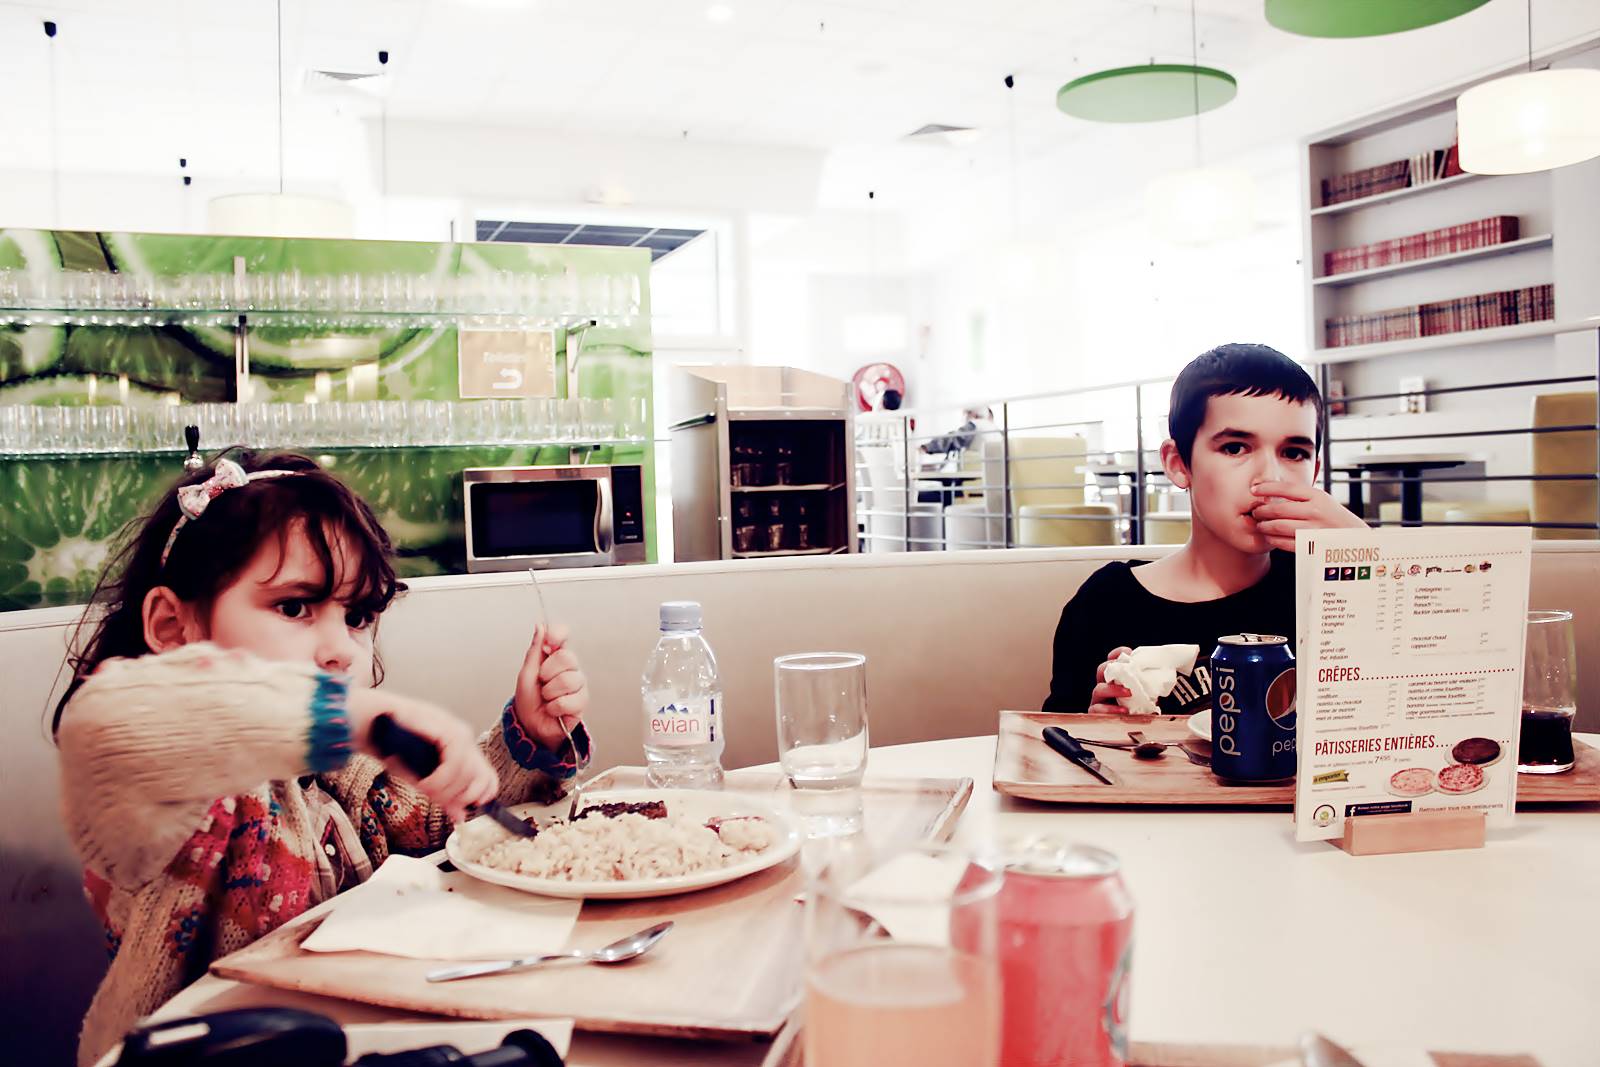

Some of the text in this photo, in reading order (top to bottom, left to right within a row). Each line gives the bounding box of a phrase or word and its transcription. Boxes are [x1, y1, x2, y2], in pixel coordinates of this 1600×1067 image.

[1325, 547, 1380, 563] BOISSONS
[1318, 666, 1360, 682] CRÊPES
[1216, 667, 1241, 756] pepsi
[652, 717, 699, 733] evian
[1273, 737, 1296, 757] pep
[1315, 733, 1435, 756] PÂTISSERIES ENTIÈRES
